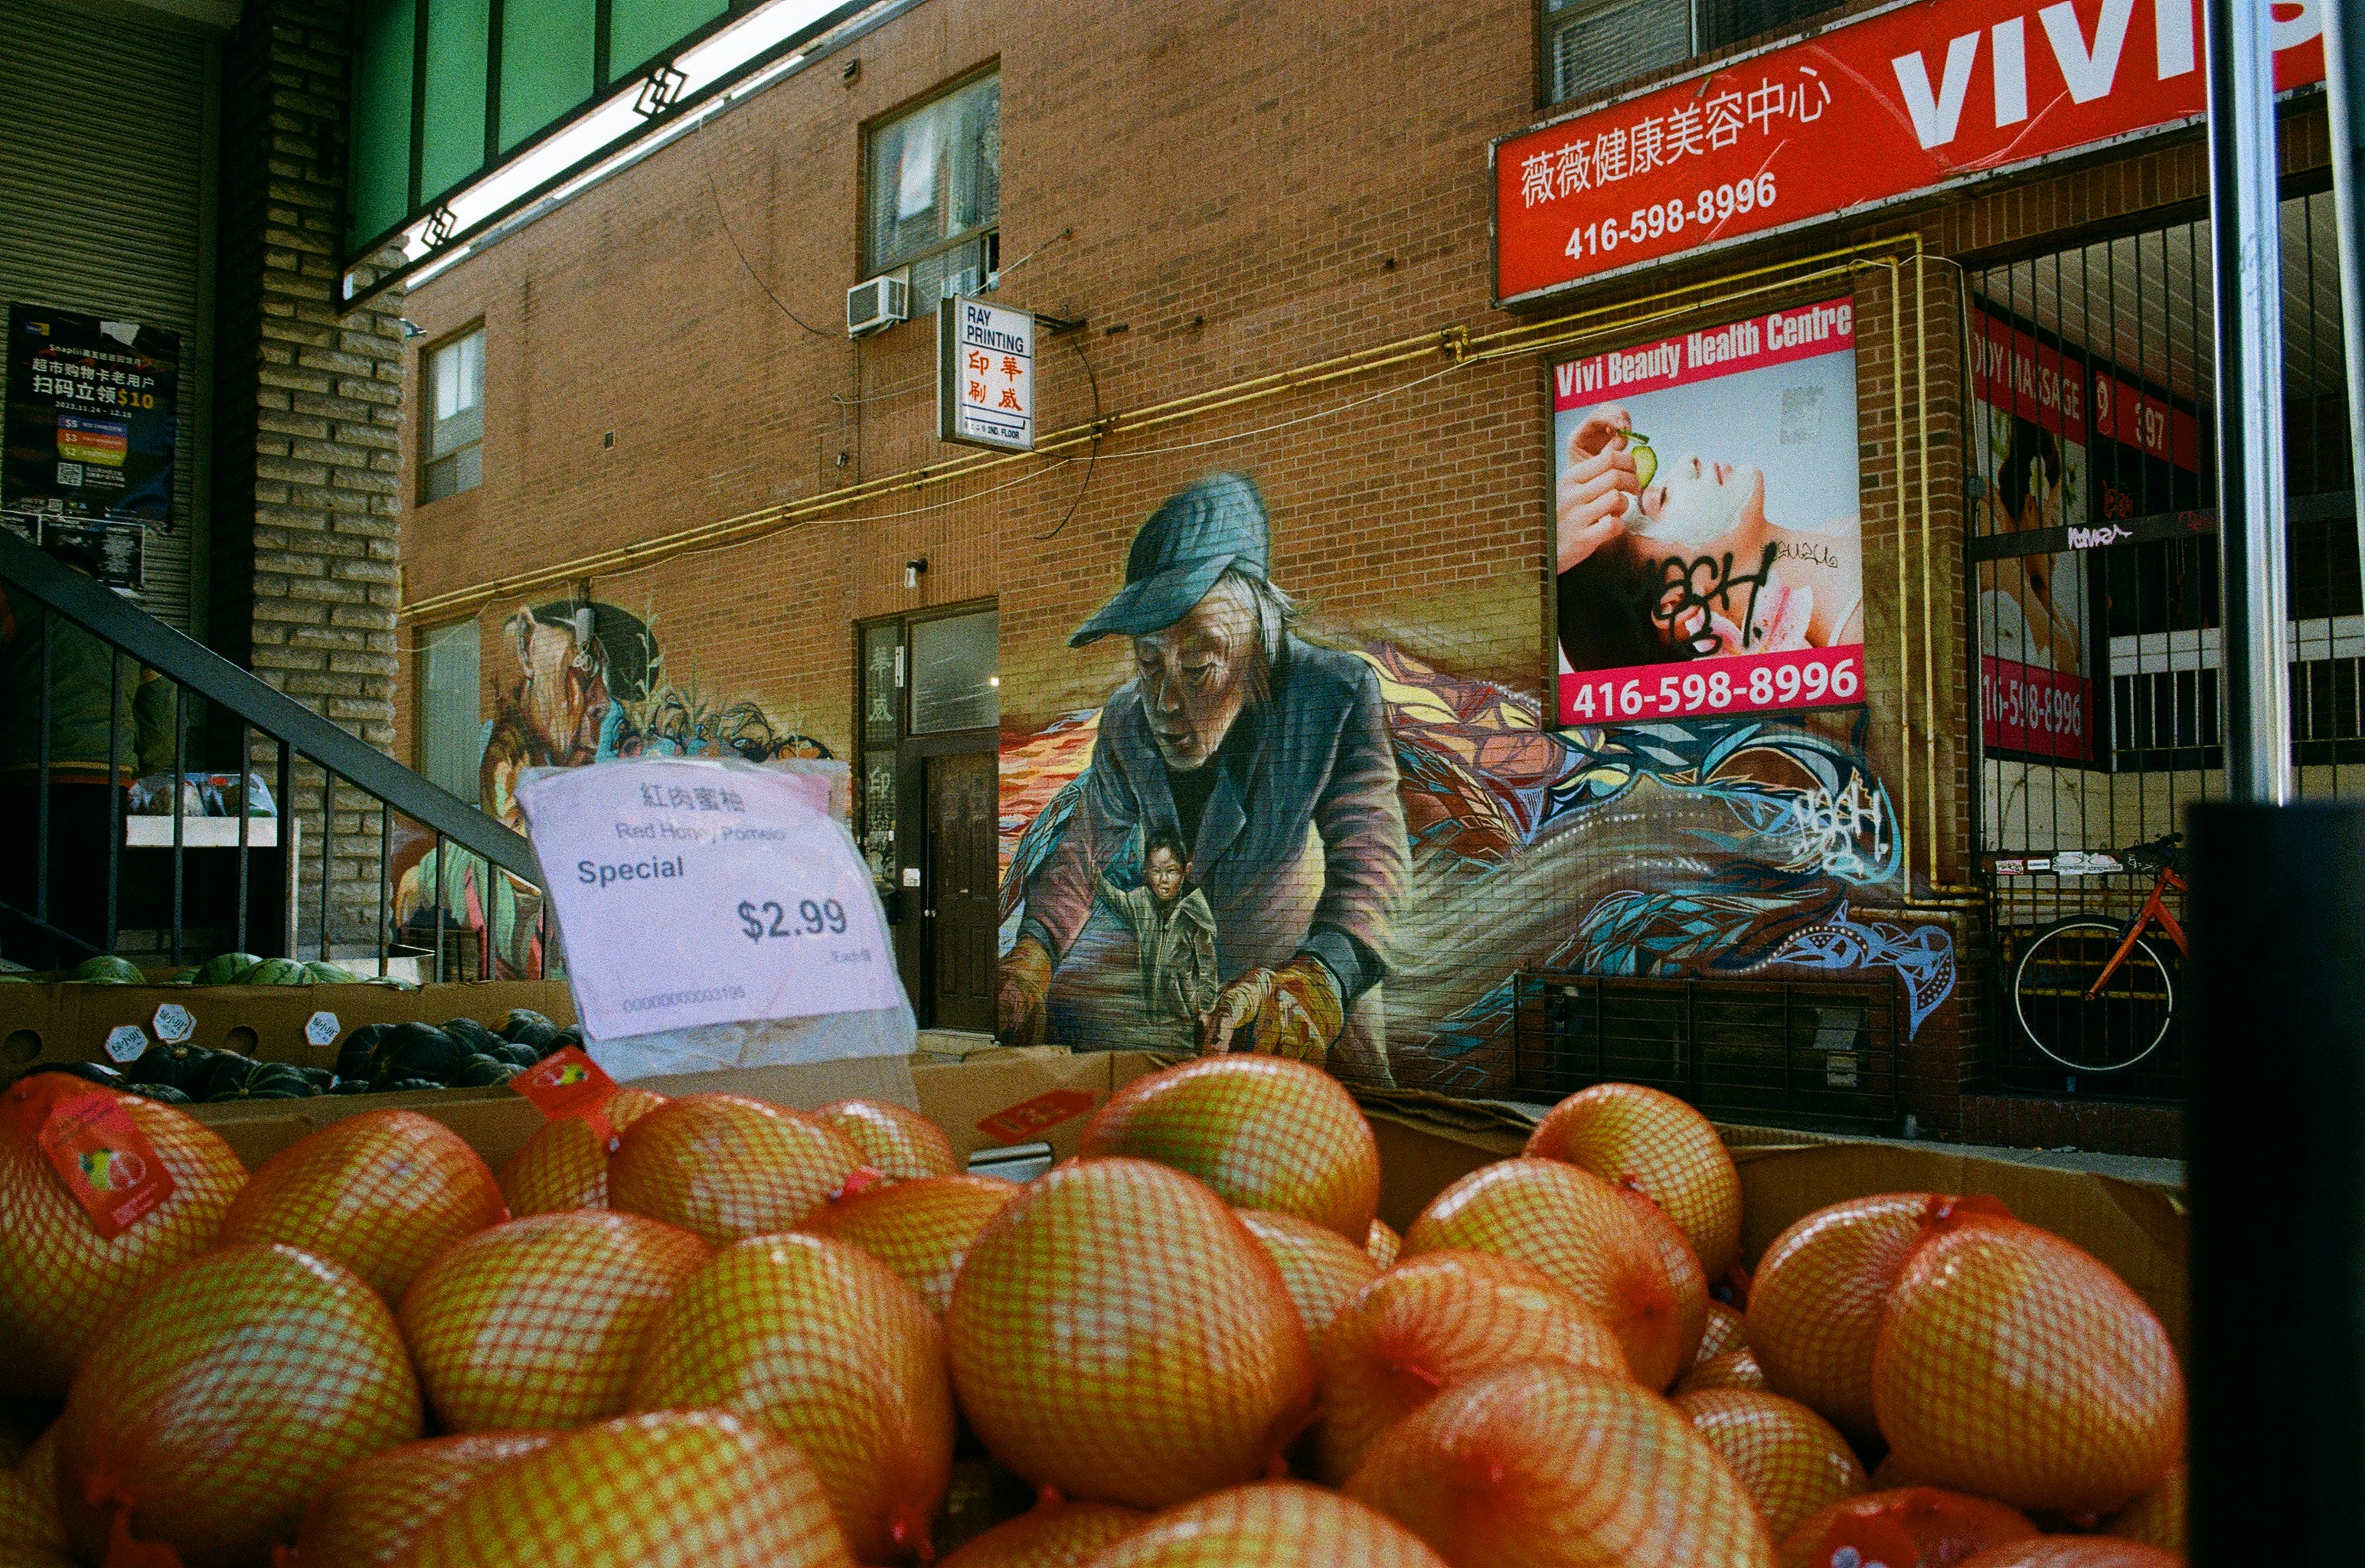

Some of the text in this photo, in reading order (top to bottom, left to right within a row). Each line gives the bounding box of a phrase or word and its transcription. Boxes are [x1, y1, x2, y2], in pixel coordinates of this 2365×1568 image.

[1891, 0, 2195, 150] VIVI
[1521, 66, 1831, 209] 薇薇健康美容中心
[1564, 172, 1777, 260] 416-598-8996
[967, 305, 991, 327] RAY
[967, 325, 1024, 354] PRINTING
[1556, 303, 1854, 397] Vivi Beauty Health Centre
[32, 358, 155, 388] 超市购物卡老用户
[968, 350, 990, 404] 印刷
[998, 356, 1024, 412] 華威
[64, 433, 77, 443] $3
[1573, 658, 1858, 719] 416-598-8996
[640, 782, 745, 812] 紅肉蜜柚
[615, 822, 655, 840] Red
[577, 855, 684, 887] Special
[737, 898, 848, 943] $2.99
